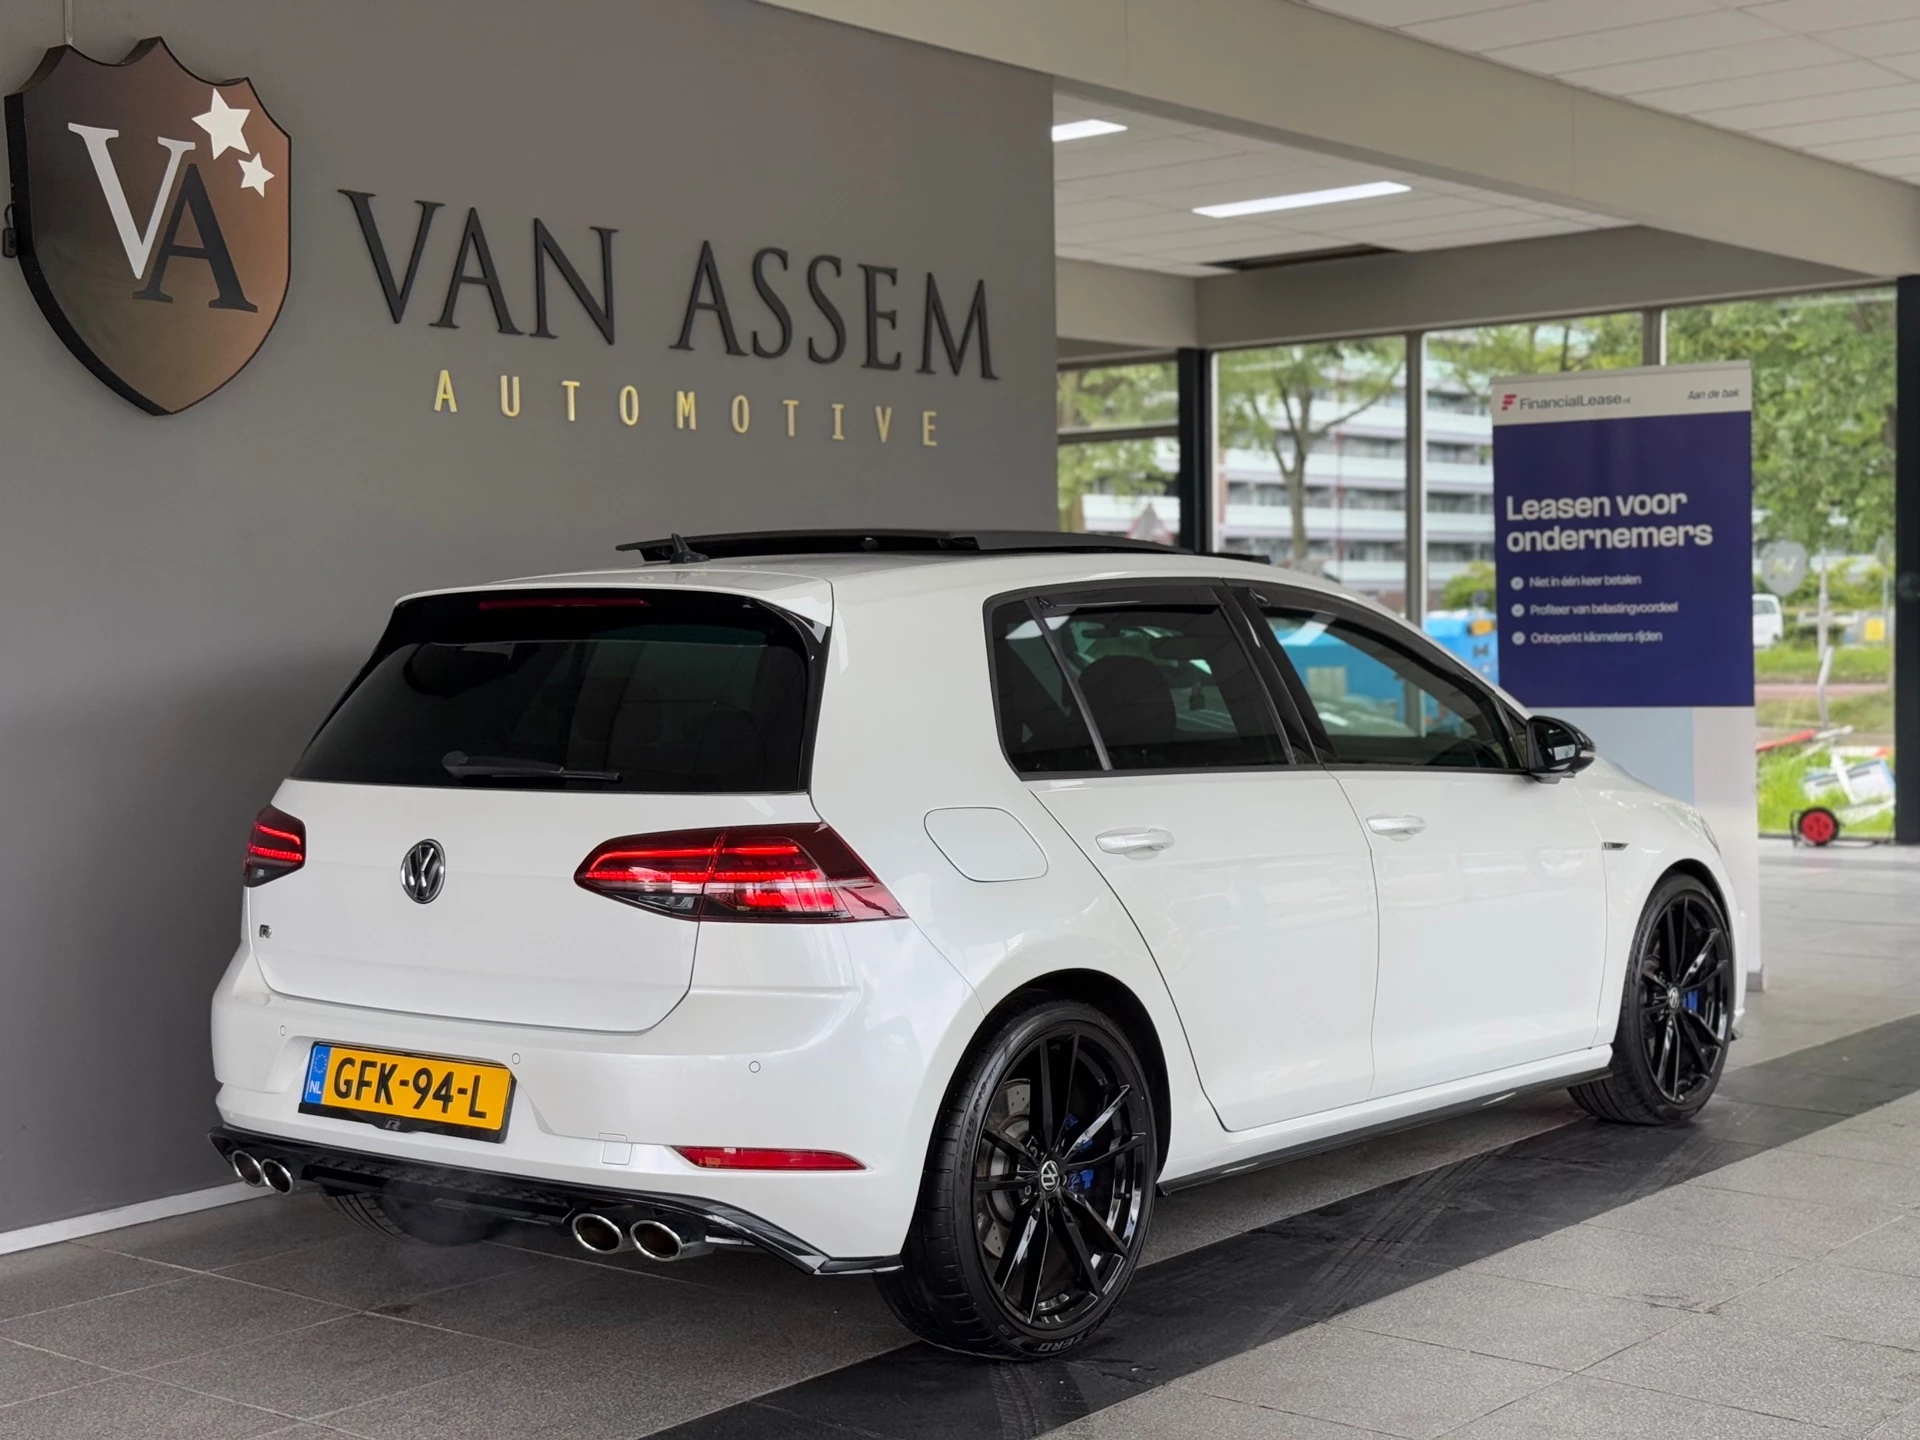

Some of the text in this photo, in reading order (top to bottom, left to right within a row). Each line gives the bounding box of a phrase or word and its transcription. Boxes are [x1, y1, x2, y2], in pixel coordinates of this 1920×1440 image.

[339, 189, 1001, 381] VAN ASSEM
[1687, 388, 1741, 400] Aan de bak
[433, 369, 939, 447] AUTOMOTIVE
[1506, 493, 1688, 521] Leasen voor
[1506, 524, 1713, 553] ondernemers
[1529, 576, 1549, 588] Niet
[1550, 576, 1560, 587] in
[1581, 575, 1602, 587] keer
[1603, 574, 1642, 586] betalen
[1530, 602, 1679, 616] Profiteer van belastingvoordeel
[1530, 630, 1663, 645] Onbeperkt kilometers rijden
[309, 1080, 322, 1095] NL
[333, 1057, 488, 1119] GFK-94-L
